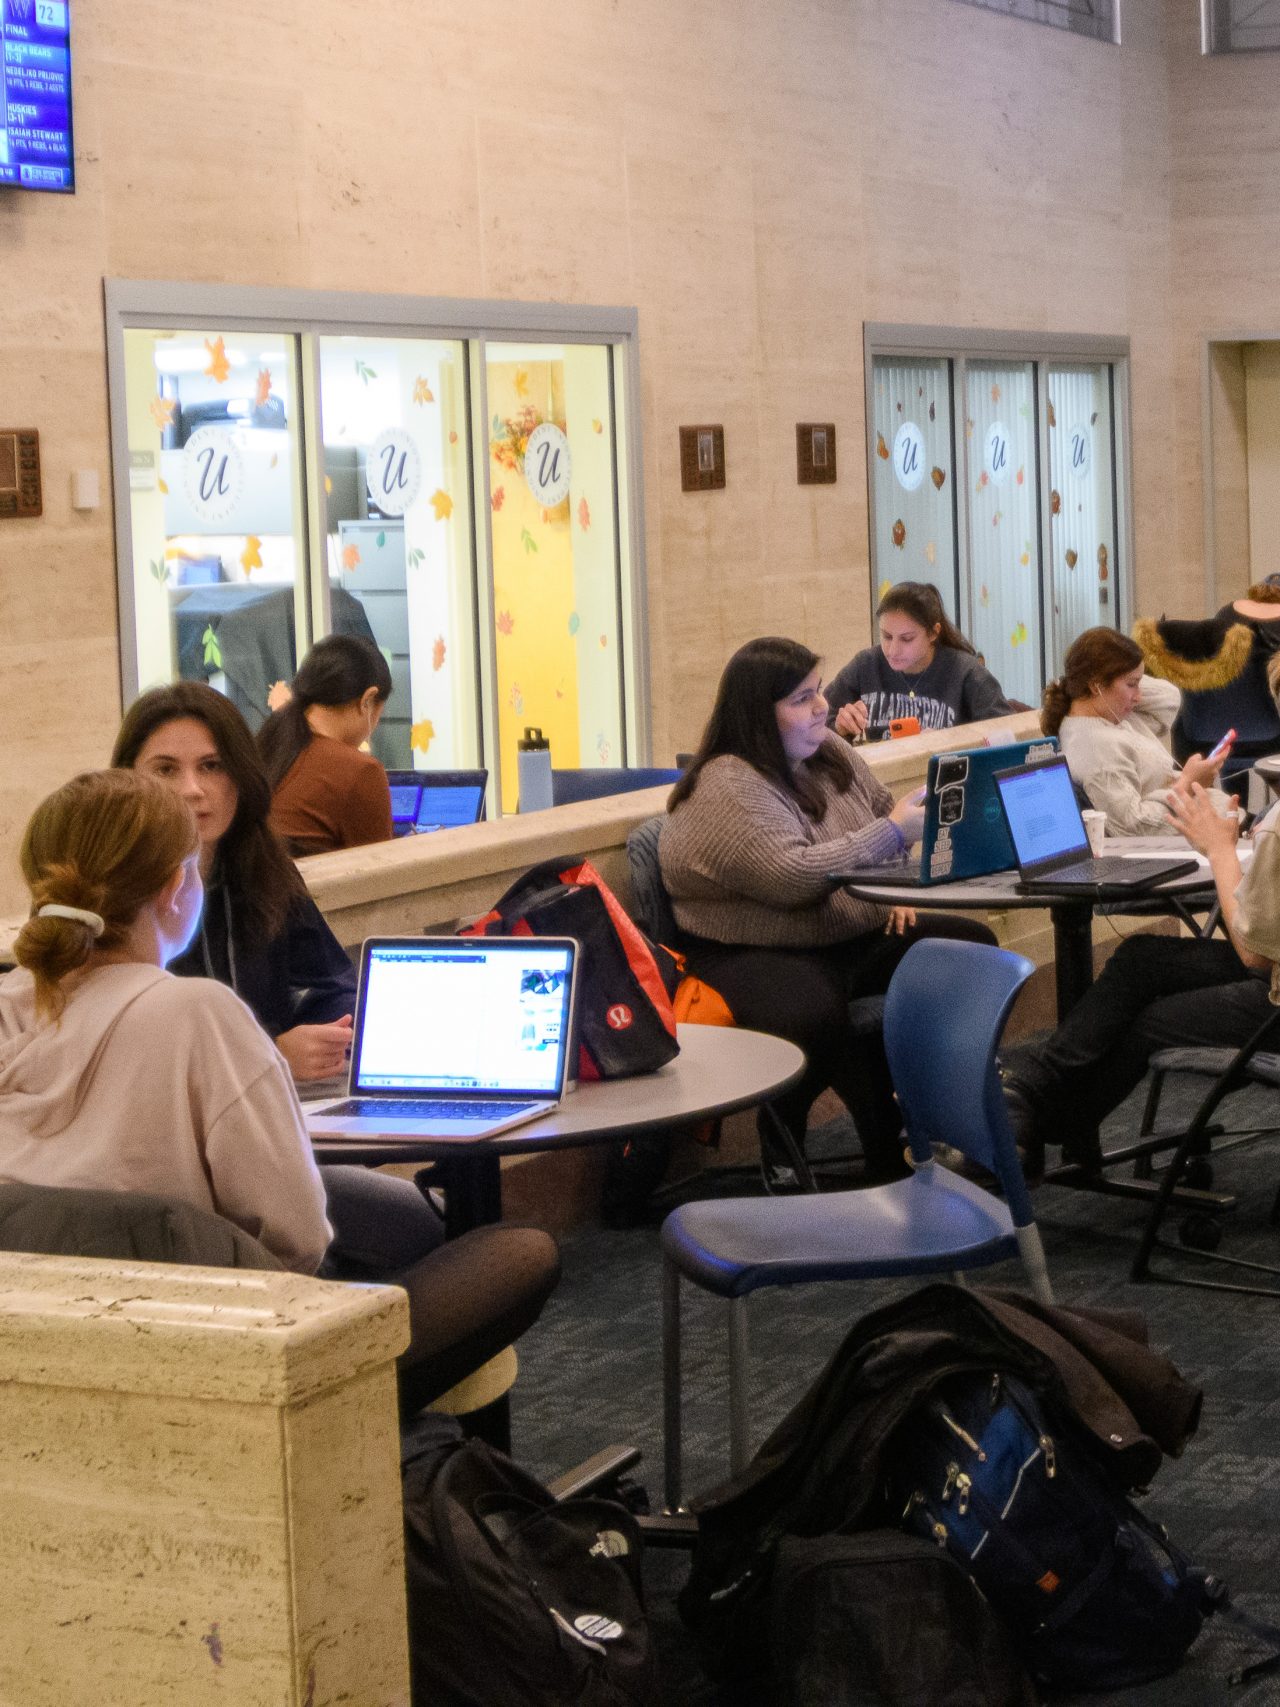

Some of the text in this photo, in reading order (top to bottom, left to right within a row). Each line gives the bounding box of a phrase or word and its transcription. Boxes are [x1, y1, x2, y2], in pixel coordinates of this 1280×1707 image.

[38, 4, 54, 21] 72
[5, 23, 28, 37] FINAL
[7, 102, 37, 116] HUSKIES
[8, 126, 63, 143] ISAIAH STEWART
